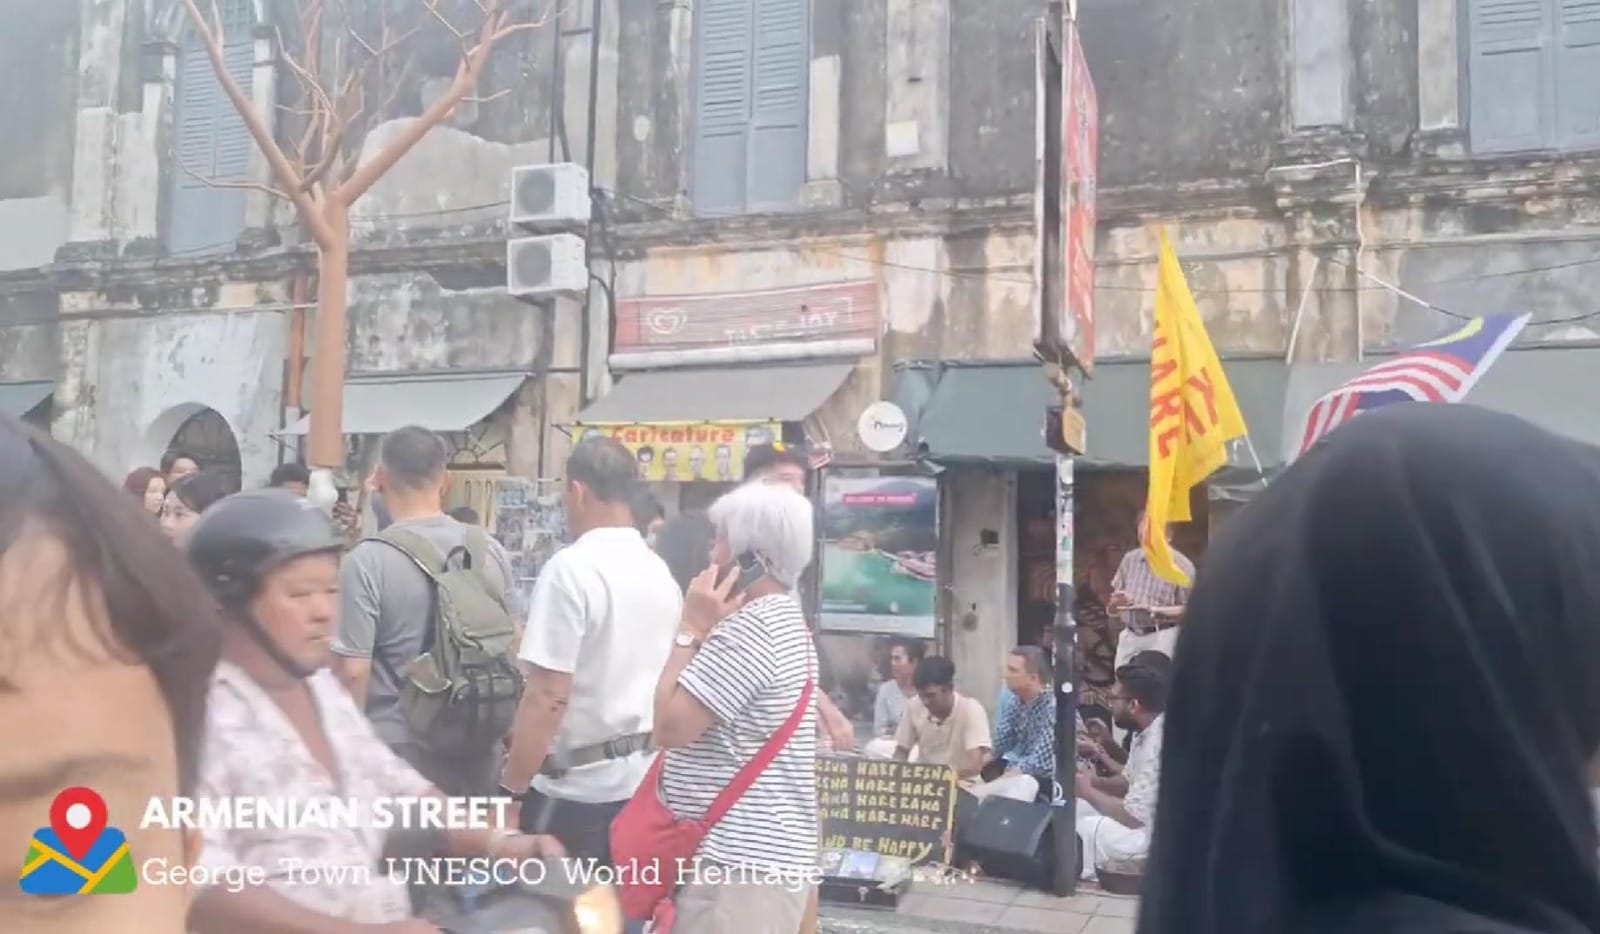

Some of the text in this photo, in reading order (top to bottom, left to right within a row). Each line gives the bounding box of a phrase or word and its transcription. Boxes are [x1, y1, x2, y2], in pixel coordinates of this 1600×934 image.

[855, 778, 897, 794] HARE
[901, 782, 945, 797] HARE
[856, 794, 898, 809] HARE
[855, 810, 897, 825] HARE
[852, 836, 874, 851] BE
[878, 836, 933, 865] HAPPY
